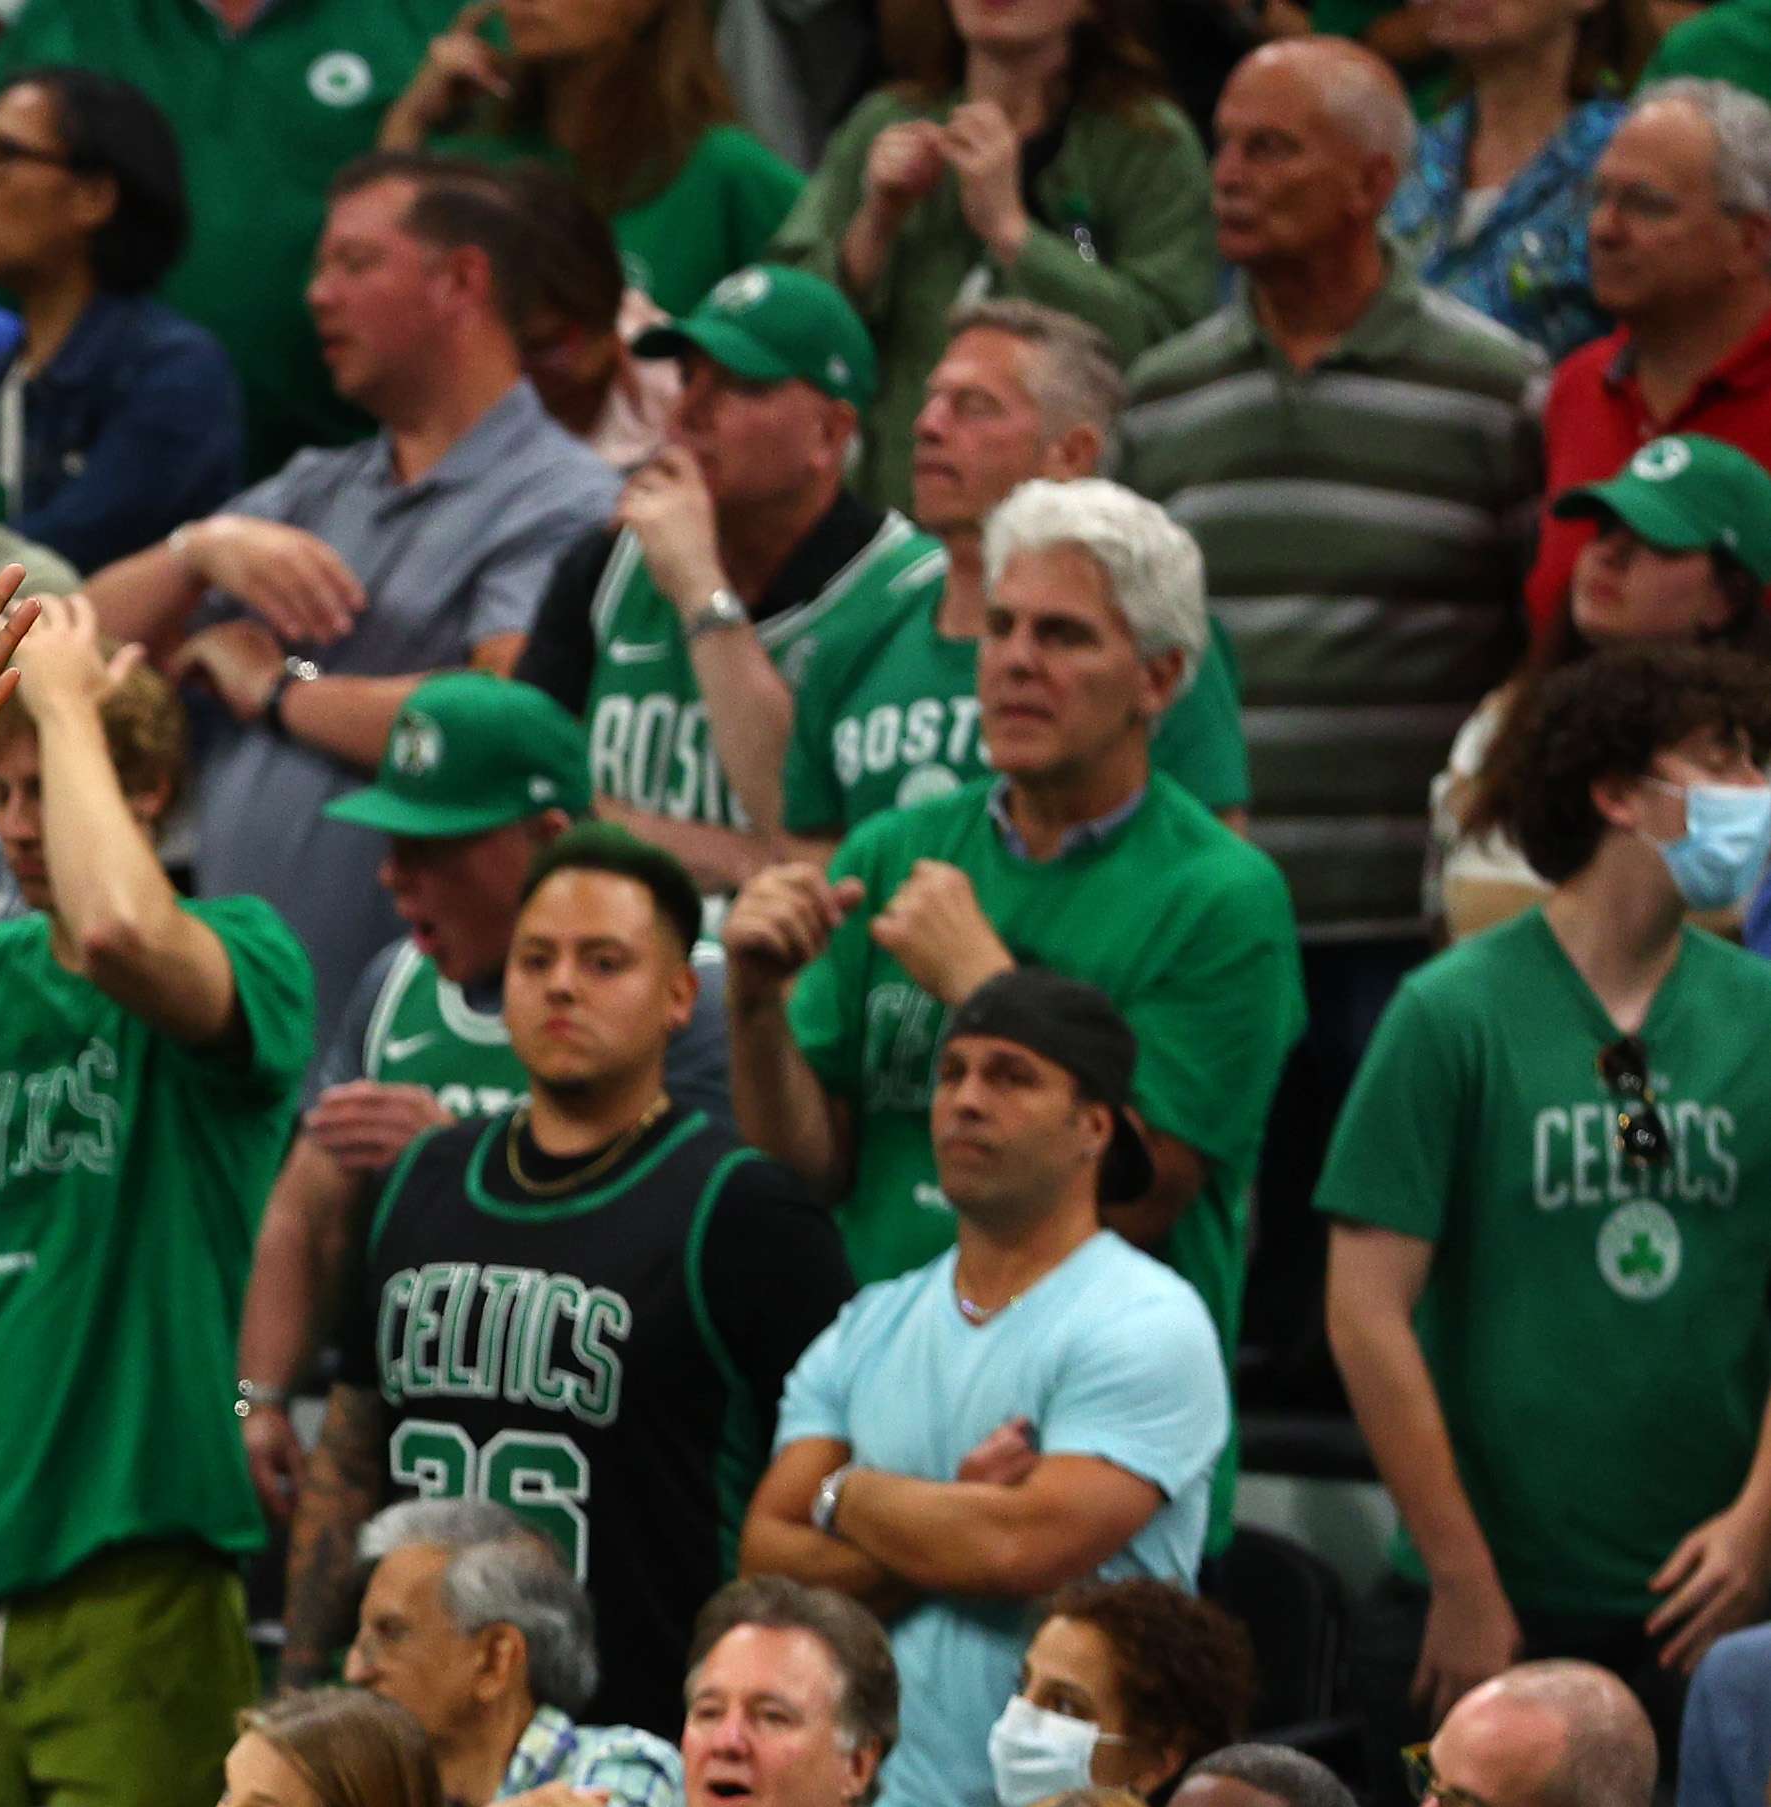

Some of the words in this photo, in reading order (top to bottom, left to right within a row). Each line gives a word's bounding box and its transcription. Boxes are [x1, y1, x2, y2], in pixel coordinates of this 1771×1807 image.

[589, 693, 753, 834] BOS
[832, 694, 997, 788] BOST
[377, 1261, 633, 1428] CELTICS
